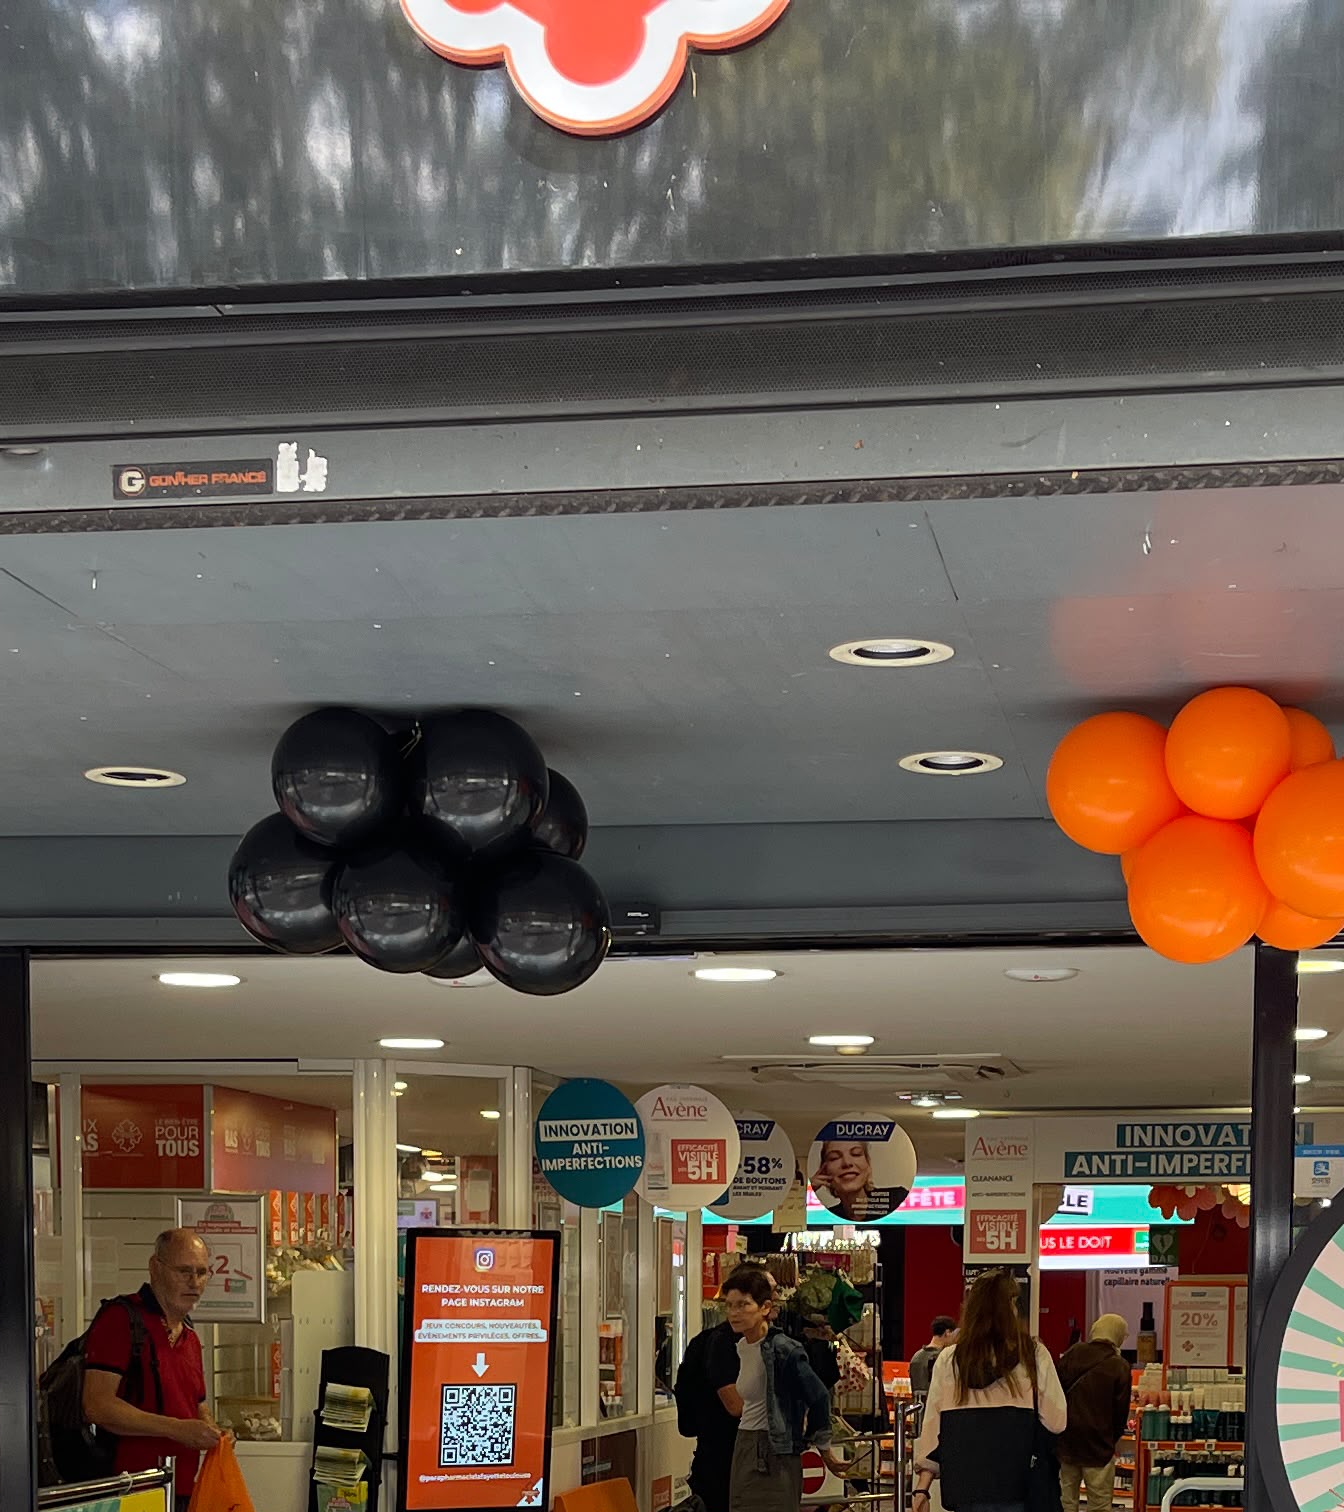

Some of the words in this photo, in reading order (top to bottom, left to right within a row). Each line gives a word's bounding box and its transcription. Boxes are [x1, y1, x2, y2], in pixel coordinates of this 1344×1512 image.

[211, 470, 267, 486] FRANCE
[650, 1096, 708, 1118] Avène
[82, 1119, 98, 1132] IX
[155, 1126, 199, 1140] POUR
[543, 1122, 635, 1138] INNOVATION
[736, 1122, 769, 1134] CRAY
[836, 1124, 890, 1136] DUCRAY
[80, 1133, 99, 1152] AS
[156, 1139, 200, 1157] TOUS
[572, 1142, 610, 1155] ANTI-
[677, 1143, 718, 1152] EFFICACITÉ
[971, 1135, 1028, 1156] Avène
[541, 1155, 643, 1171] IMPERFECTIONS
[687, 1160, 718, 1181] 5H
[746, 1177, 787, 1185] BOUTONS
[909, 1188, 956, 1207] FÊTE
[985, 1230, 1017, 1250] 5H
[1039, 1236, 1057, 1249] US
[1059, 1236, 1075, 1249] LE
[1077, 1236, 1112, 1249] DOIT
[421, 1284, 490, 1294] RENDEZ-VOUS
[491, 1284, 511, 1294] SUR
[512, 1284, 545, 1294] NOTRE
[441, 1298, 467, 1307] PAGE
[469, 1298, 525, 1307] INSTAGRAM
[1180, 1311, 1219, 1327] 20%
